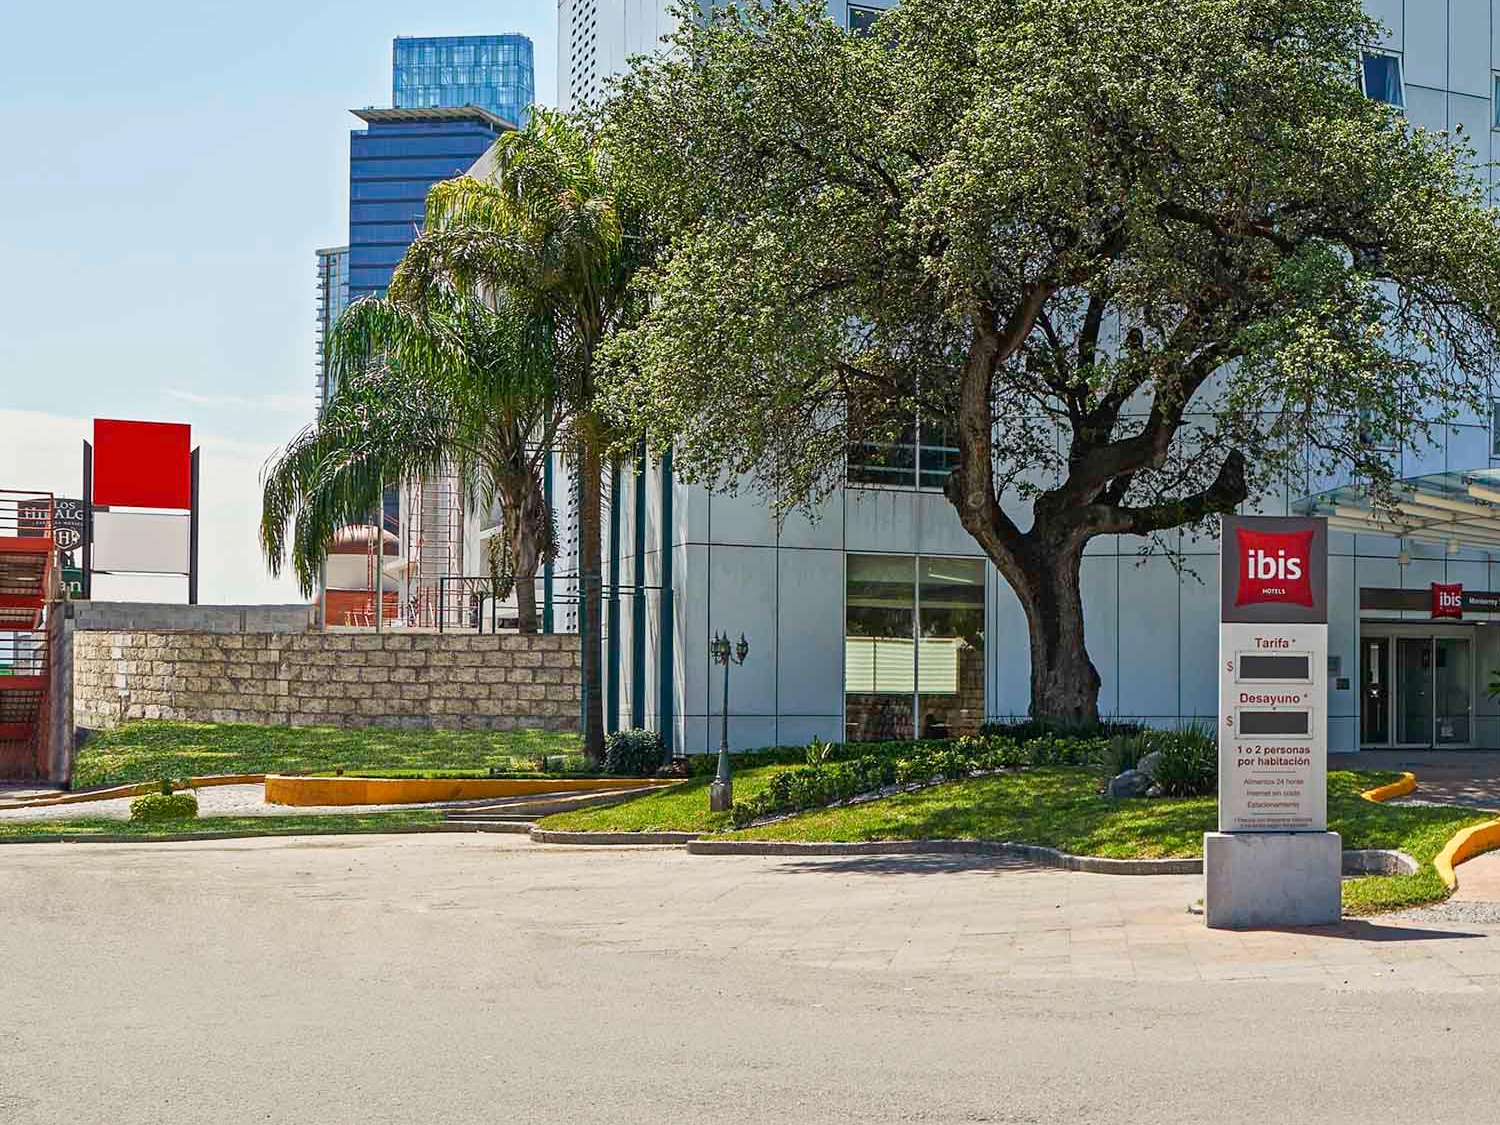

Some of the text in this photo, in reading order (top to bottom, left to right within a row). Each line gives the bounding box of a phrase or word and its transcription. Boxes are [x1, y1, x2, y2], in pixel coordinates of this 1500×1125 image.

[1248, 549, 1302, 579] ibis
[1439, 592, 1461, 606] ibis
[1254, 637, 1289, 648] Tarifa
[1240, 693, 1300, 705] Desayuno
[1237, 745, 1242, 754] 1
[1255, 745, 1261, 754] 2
[1264, 746, 1310, 755] personas
[1238, 756, 1310, 767] por habitación
